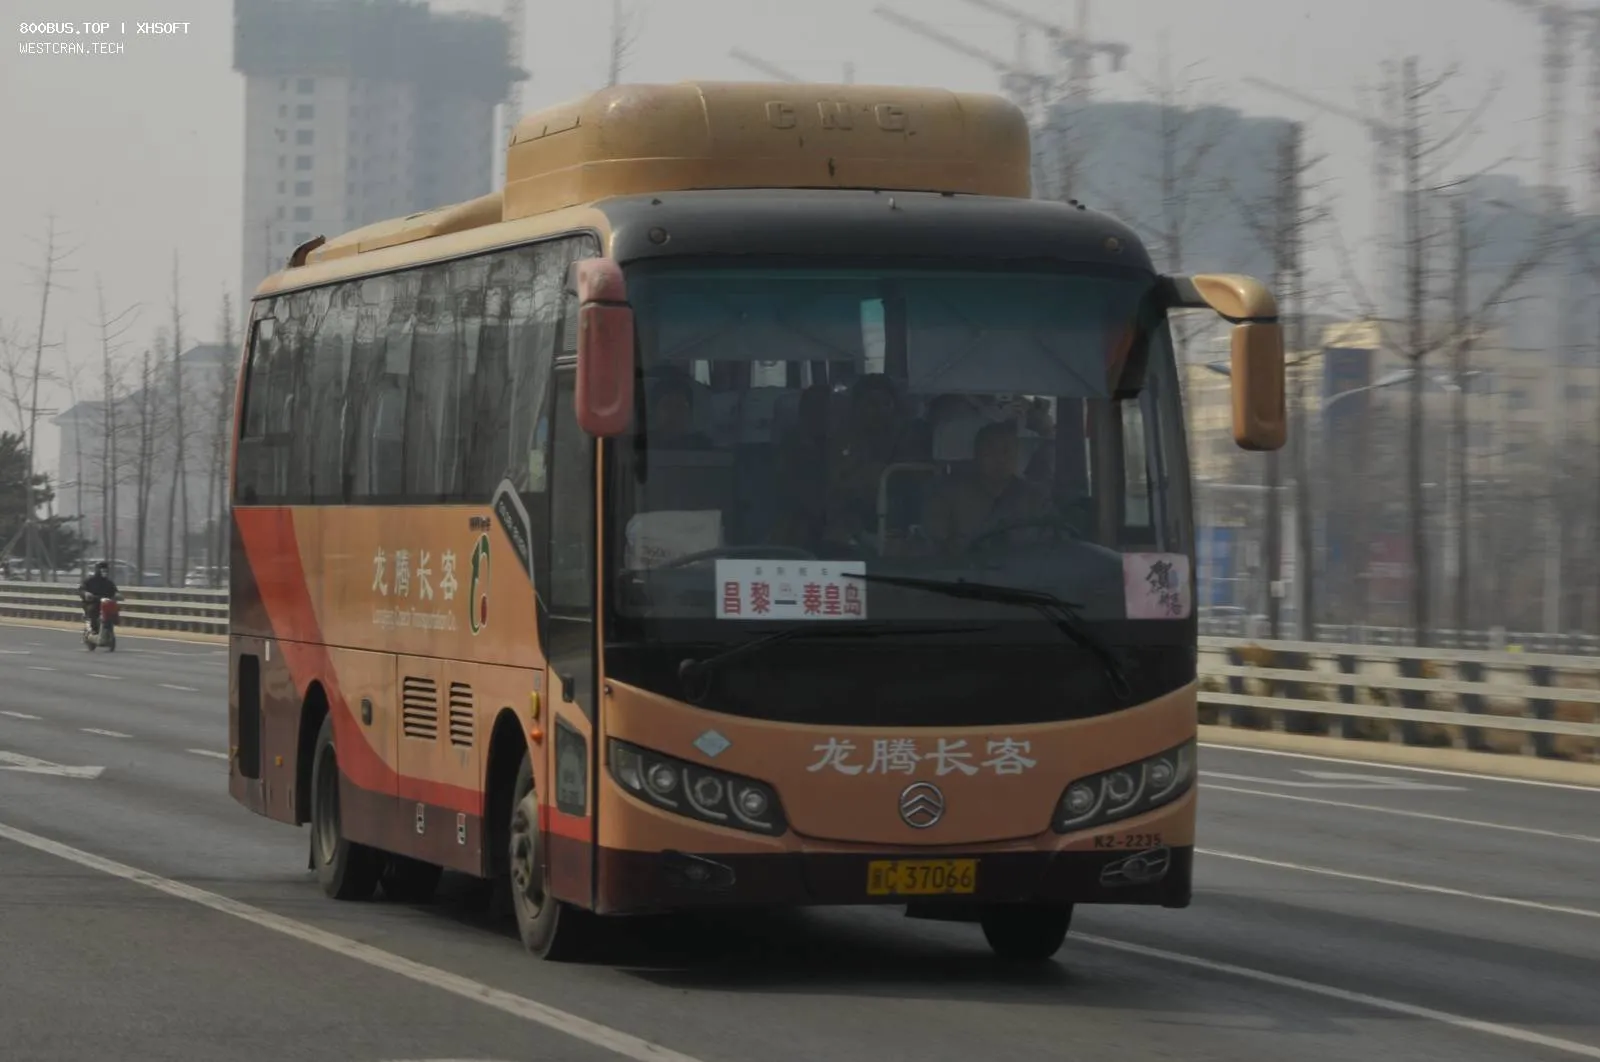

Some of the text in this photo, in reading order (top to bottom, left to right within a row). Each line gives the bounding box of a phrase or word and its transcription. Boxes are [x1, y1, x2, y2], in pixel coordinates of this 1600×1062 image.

[372, 546, 458, 601] 龙腾长客
[806, 737, 1037, 776] 龙腾长客
